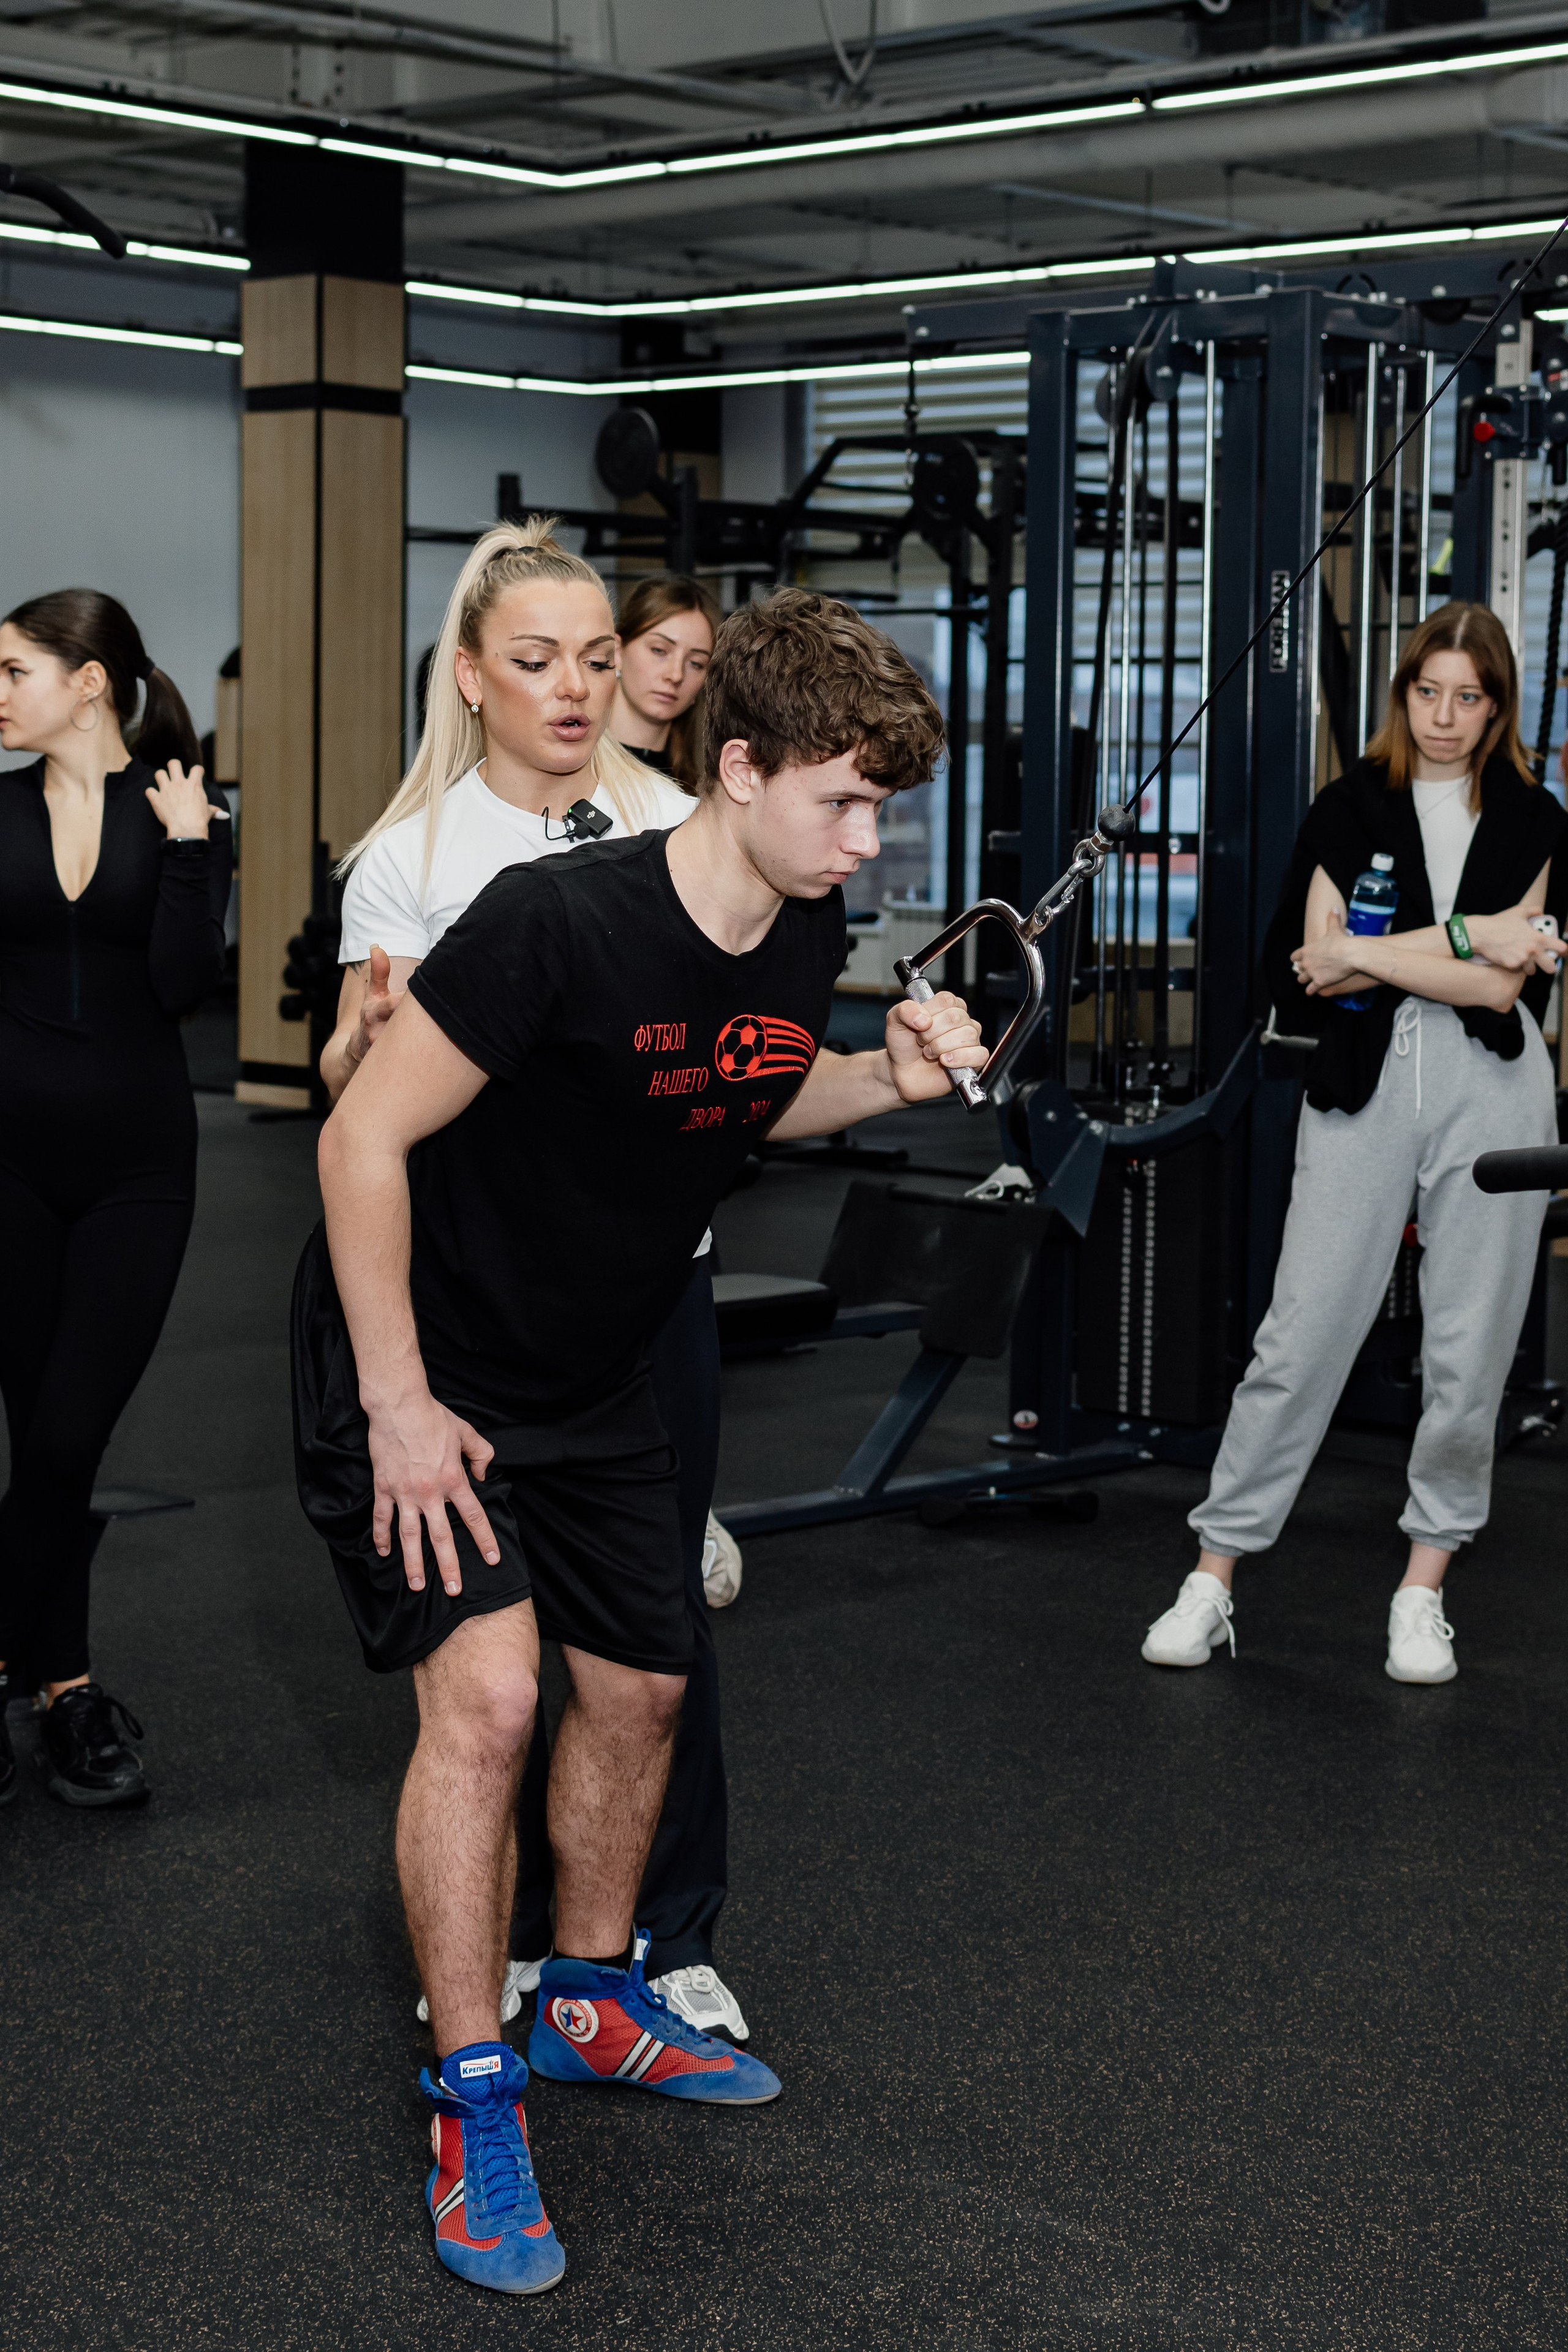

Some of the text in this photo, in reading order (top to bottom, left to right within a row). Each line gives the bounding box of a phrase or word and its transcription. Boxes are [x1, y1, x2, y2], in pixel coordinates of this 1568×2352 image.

[634, 1023, 687, 1052] ФУТБОЛ
[647, 1067, 709, 1095] НАШЕГО
[678, 1106, 726, 1132] ДВОРА
